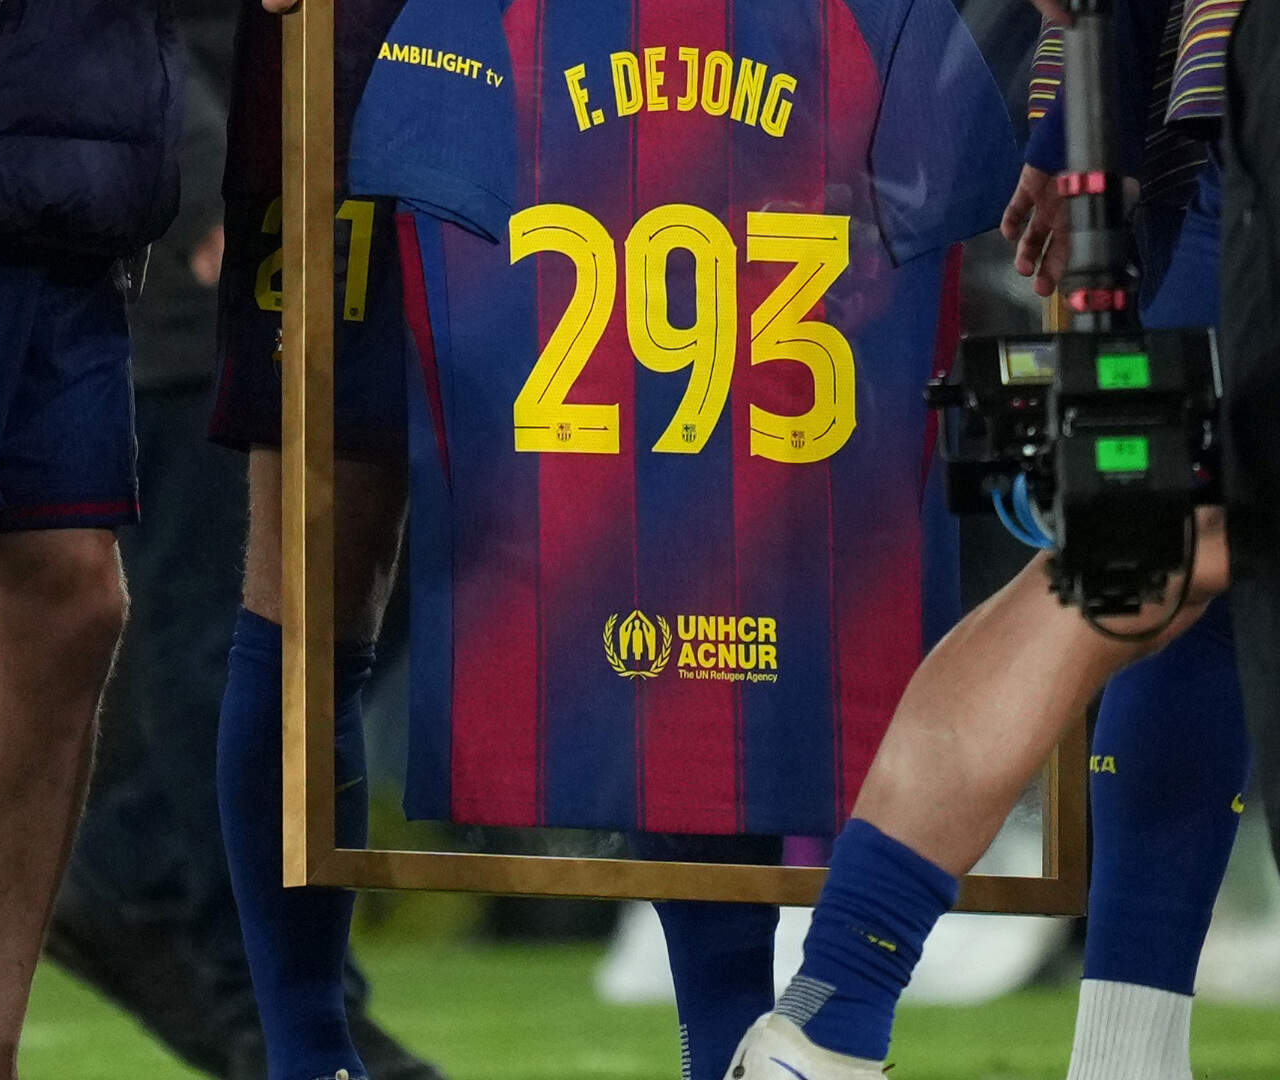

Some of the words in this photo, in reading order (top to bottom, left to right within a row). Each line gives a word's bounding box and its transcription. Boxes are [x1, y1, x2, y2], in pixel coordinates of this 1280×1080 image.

[378, 42, 482, 79] AMBILIGHT
[486, 68, 503, 88] tv
[564, 63, 605, 132] F.
[610, 46, 669, 117] DE
[677, 46, 798, 137] JONG
[509, 203, 857, 463] 293
[677, 615, 777, 642] UNHCR
[677, 642, 778, 669] ACNUR
[679, 669, 694, 680] The
[696, 670, 709, 680] UN
[710, 670, 745, 682] Refugee
[746, 672, 778, 683] Agency
